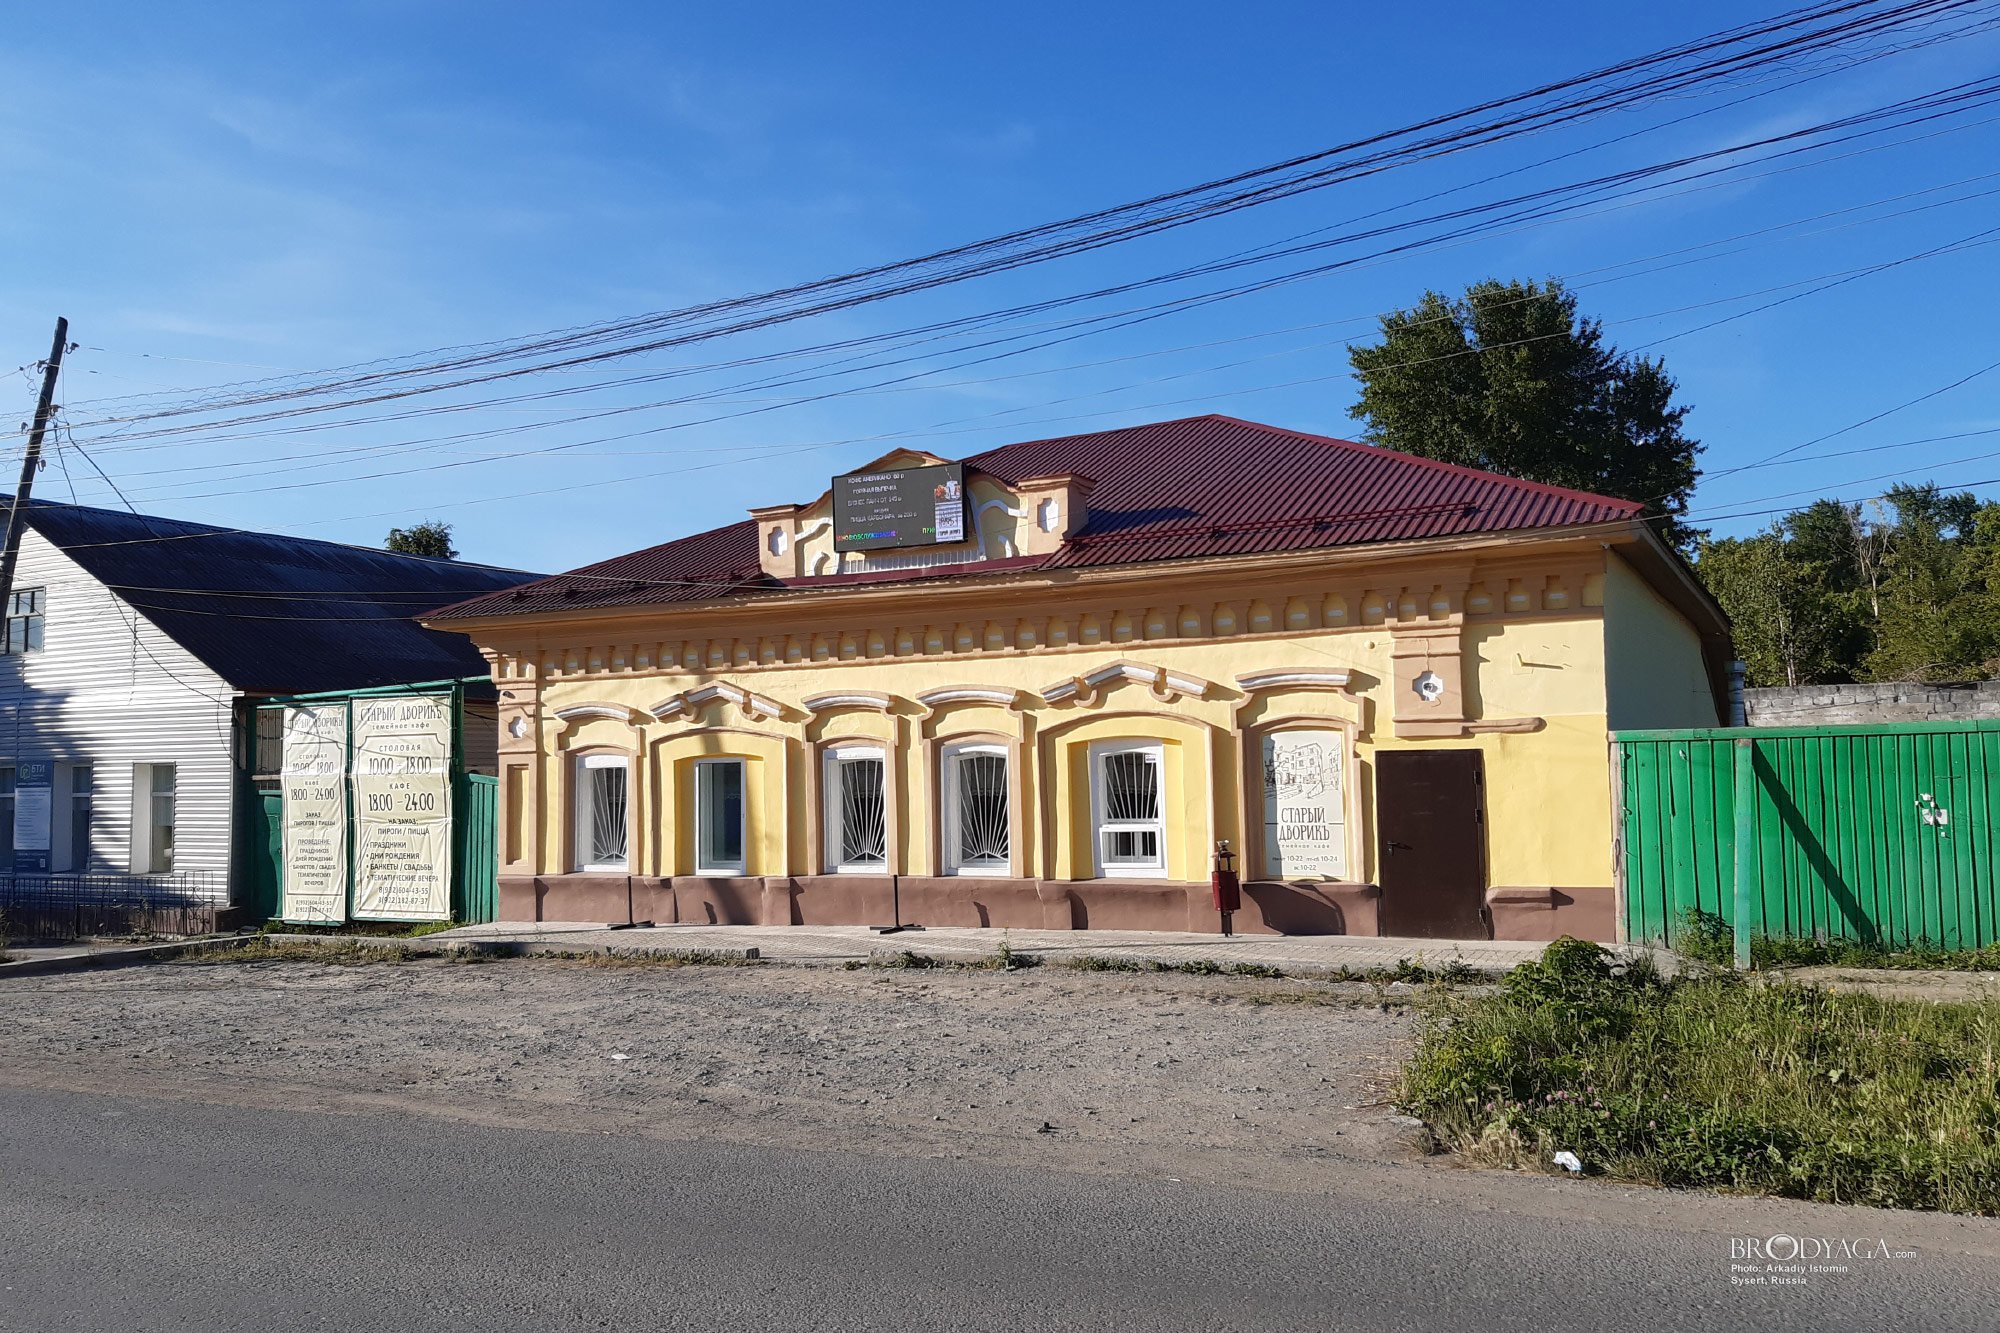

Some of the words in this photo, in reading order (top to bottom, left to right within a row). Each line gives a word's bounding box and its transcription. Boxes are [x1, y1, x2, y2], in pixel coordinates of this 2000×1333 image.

[361, 706, 396, 721] СТАРЫЙ
[400, 705, 442, 720] ДВОРИКЪ
[32, 764, 45, 772] БТИ
[1282, 806, 1326, 824] СТАРЫЙ
[408, 828, 430, 836] ПИЦЦА
[1278, 825, 1330, 842] ДВОРИКЪ
[385, 852, 420, 860] РОЖДЕНИЯ
